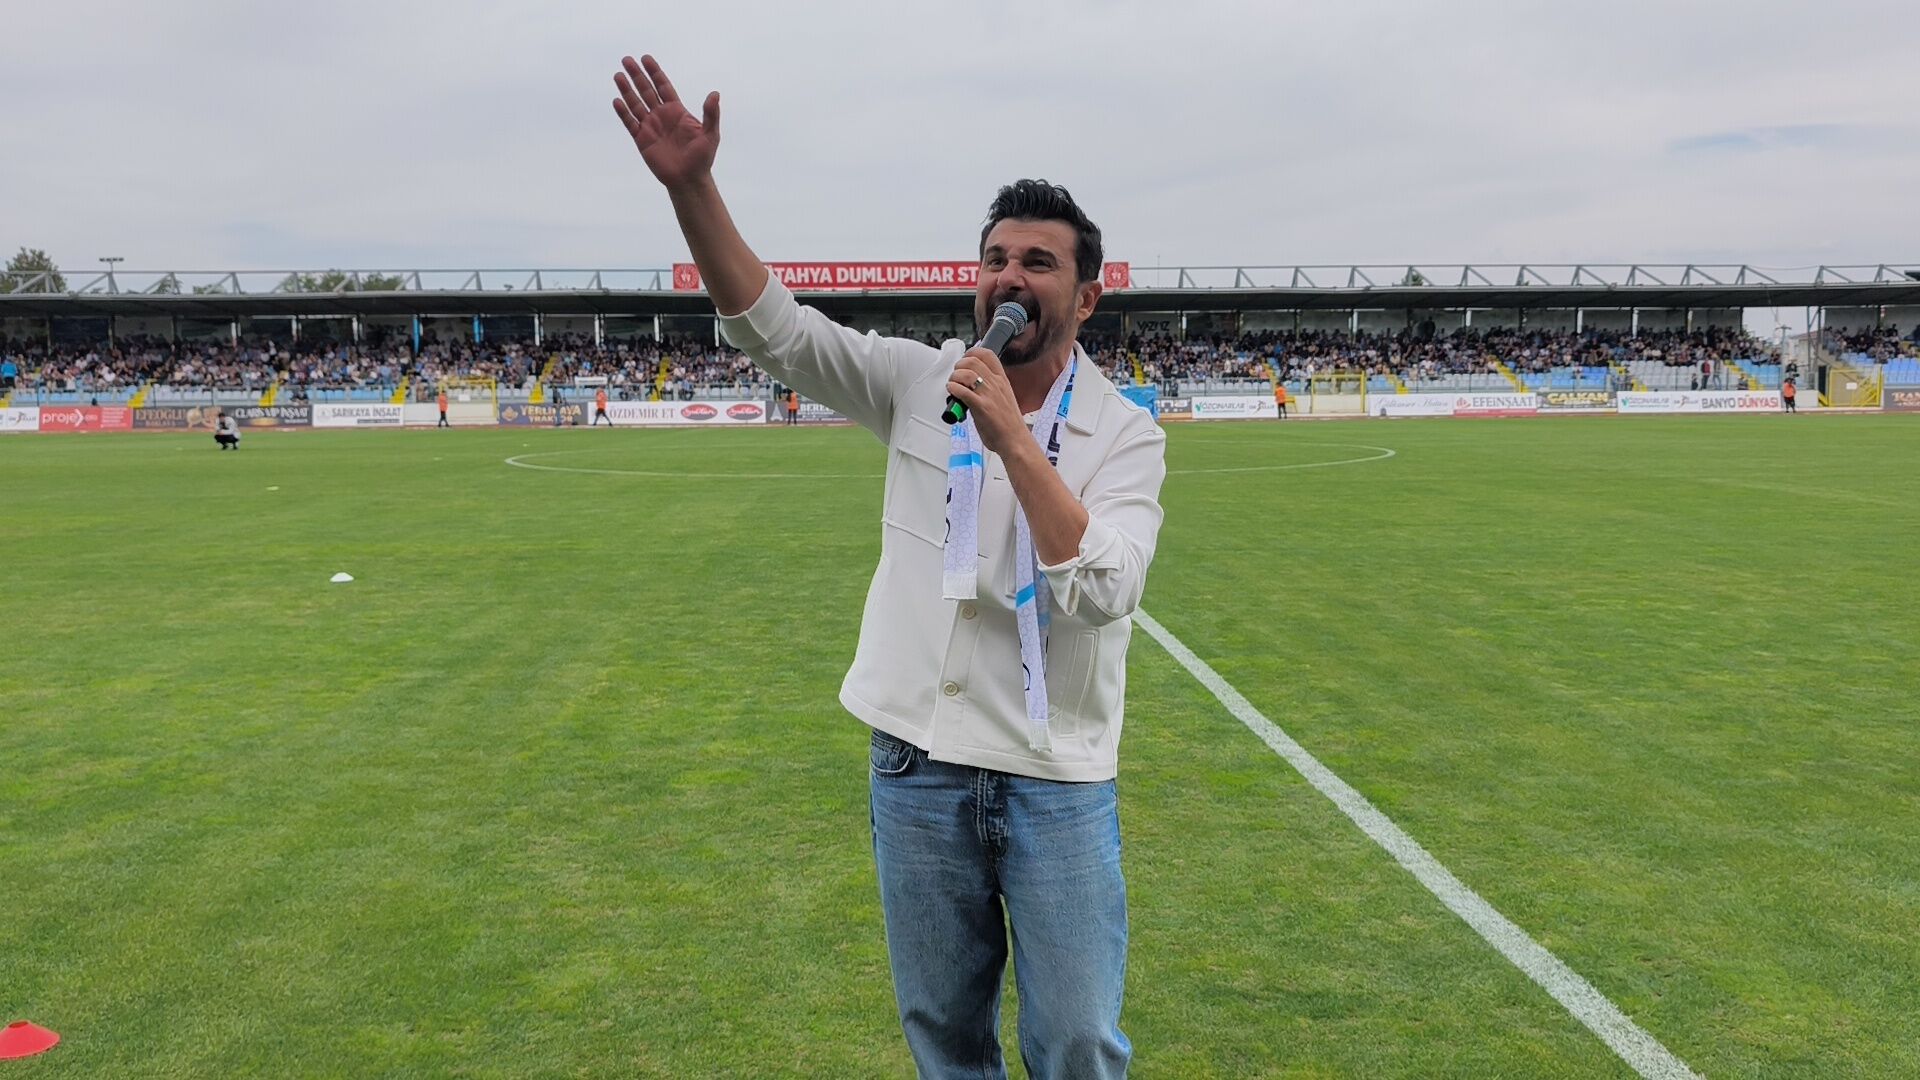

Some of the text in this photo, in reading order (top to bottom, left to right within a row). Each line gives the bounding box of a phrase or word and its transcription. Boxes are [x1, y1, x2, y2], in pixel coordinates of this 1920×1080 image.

[768, 264, 979, 283] TAHYA DUMLUPINAR ST
[1701, 397, 1736, 408] BANYO
[1737, 394, 1779, 408] DÜNYASI
[609, 405, 675, 418] ÖZDEMİR ET
